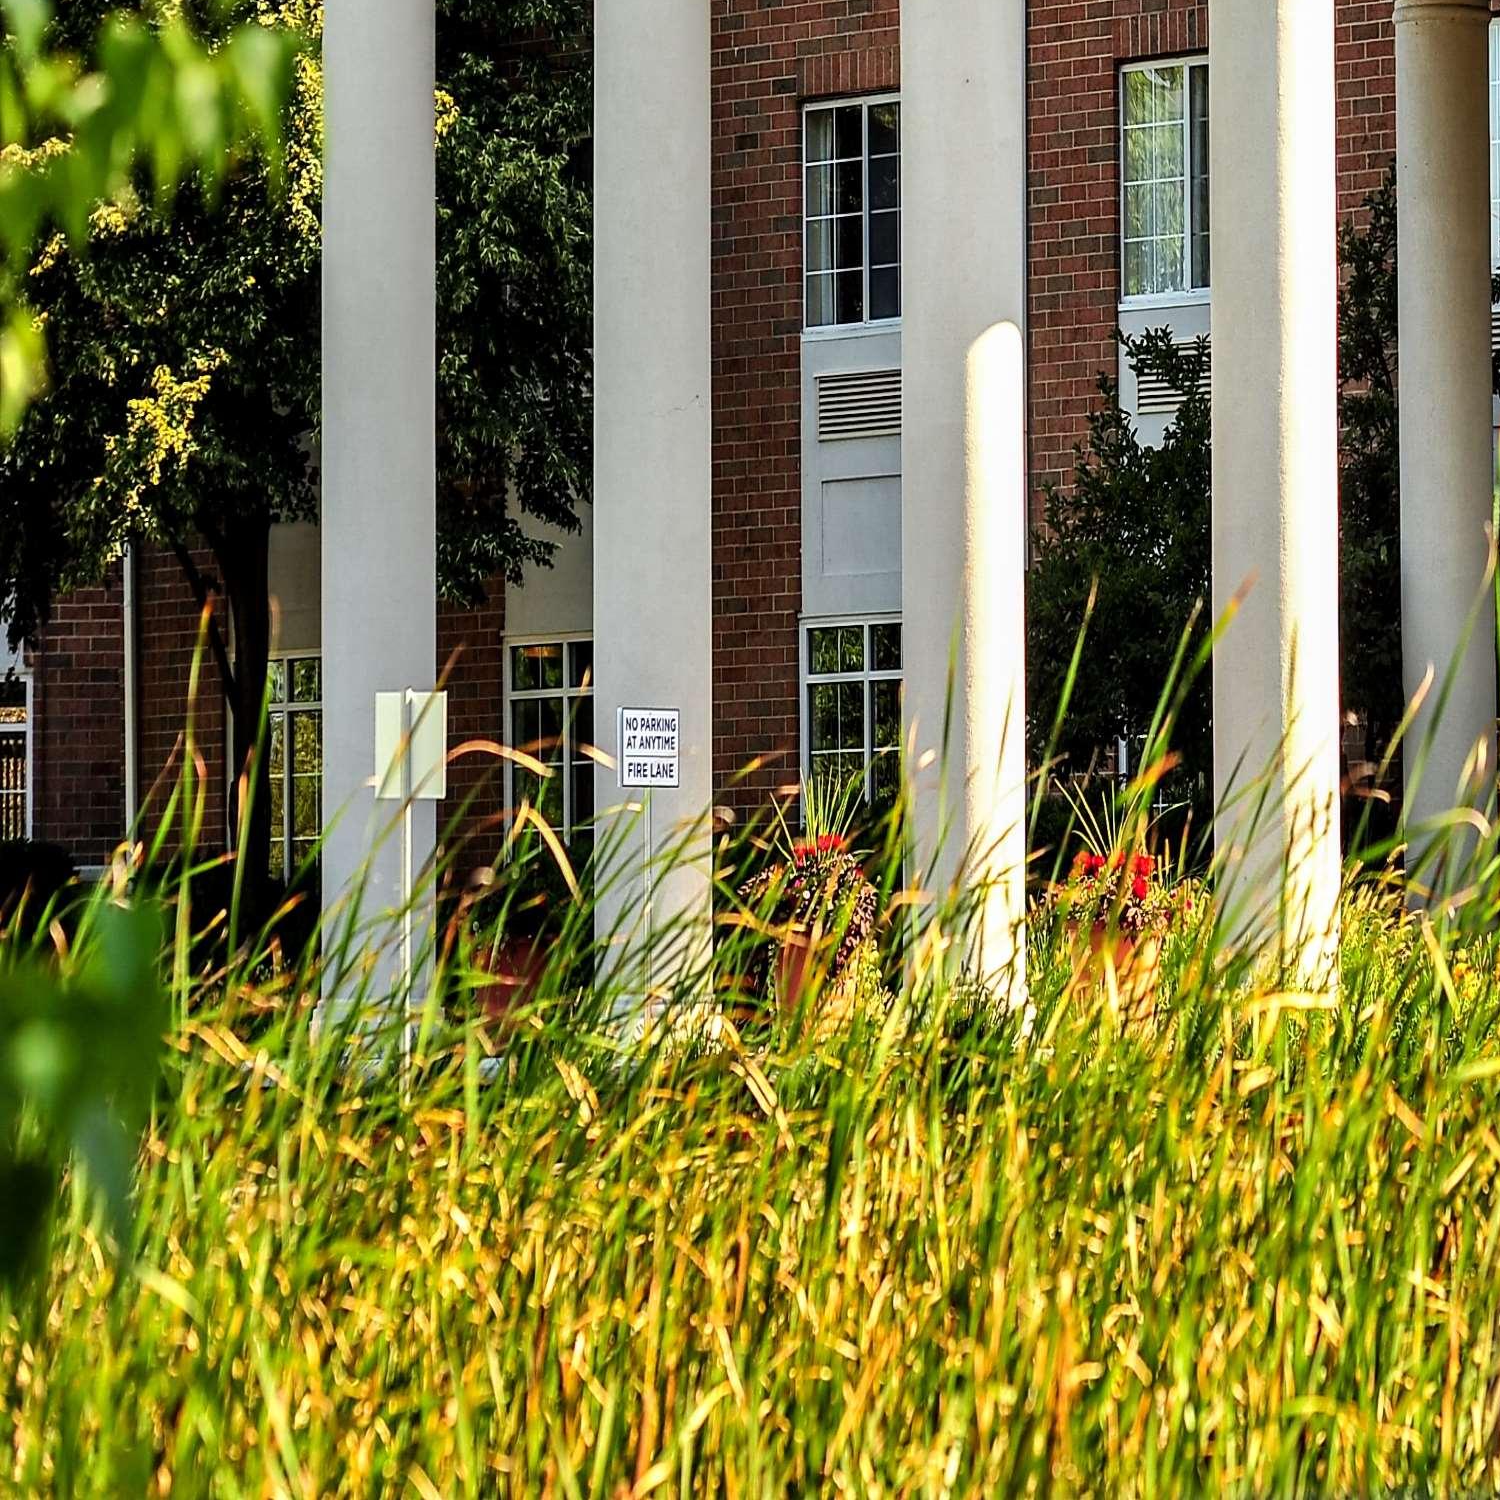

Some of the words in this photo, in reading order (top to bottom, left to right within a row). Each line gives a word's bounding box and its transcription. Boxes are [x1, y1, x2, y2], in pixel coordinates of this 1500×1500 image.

[626, 717, 638, 731] NO
[640, 717, 676, 732] PARKING
[626, 736, 637, 749] AT
[639, 736, 675, 750] ANYTIME
[628, 762, 648, 778] FIRE
[650, 763, 674, 778] LANE
